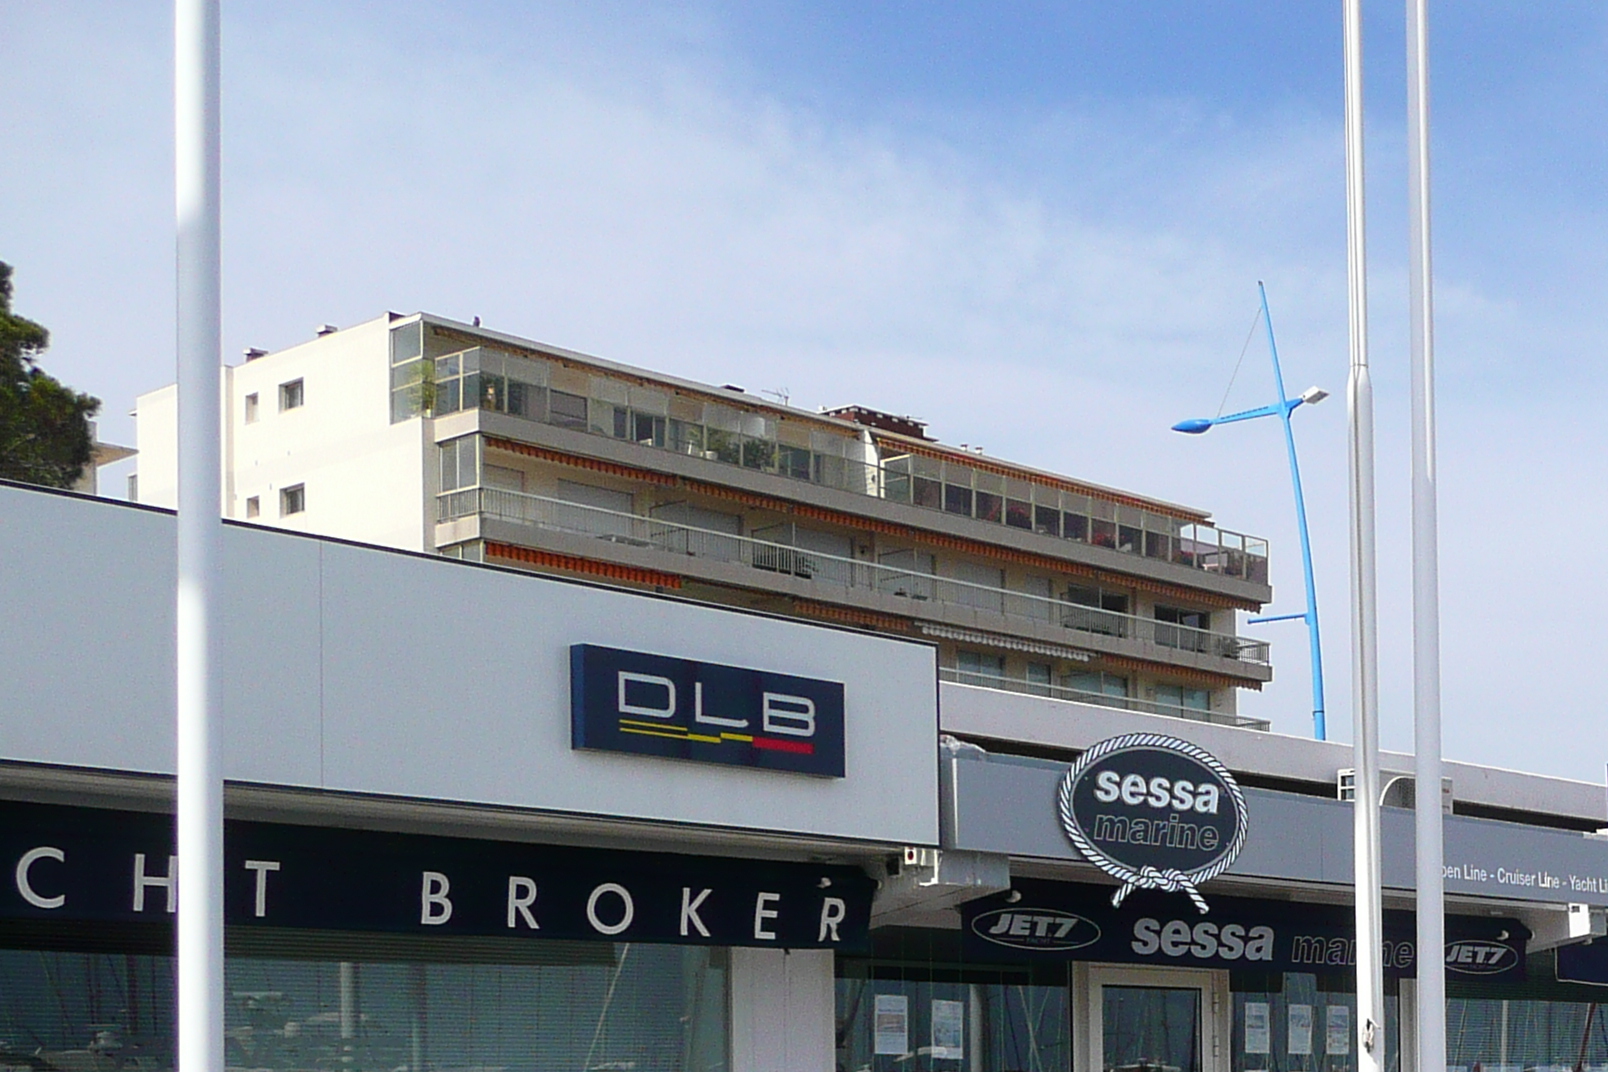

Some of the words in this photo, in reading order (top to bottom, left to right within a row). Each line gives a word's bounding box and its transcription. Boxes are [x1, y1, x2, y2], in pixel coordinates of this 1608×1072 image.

[617, 670, 816, 738] DLB
[1094, 770, 1221, 815] sessa
[1093, 813, 1220, 851] marine
[1463, 863, 1487, 882] Line
[1497, 867, 1535, 887] Cruiser
[1538, 871, 1560, 889] Line
[1569, 875, 1597, 893] Yacht
[420, 870, 846, 942] BROKER
[1131, 917, 1276, 961] sessa
[1291, 935, 1415, 968] marne
